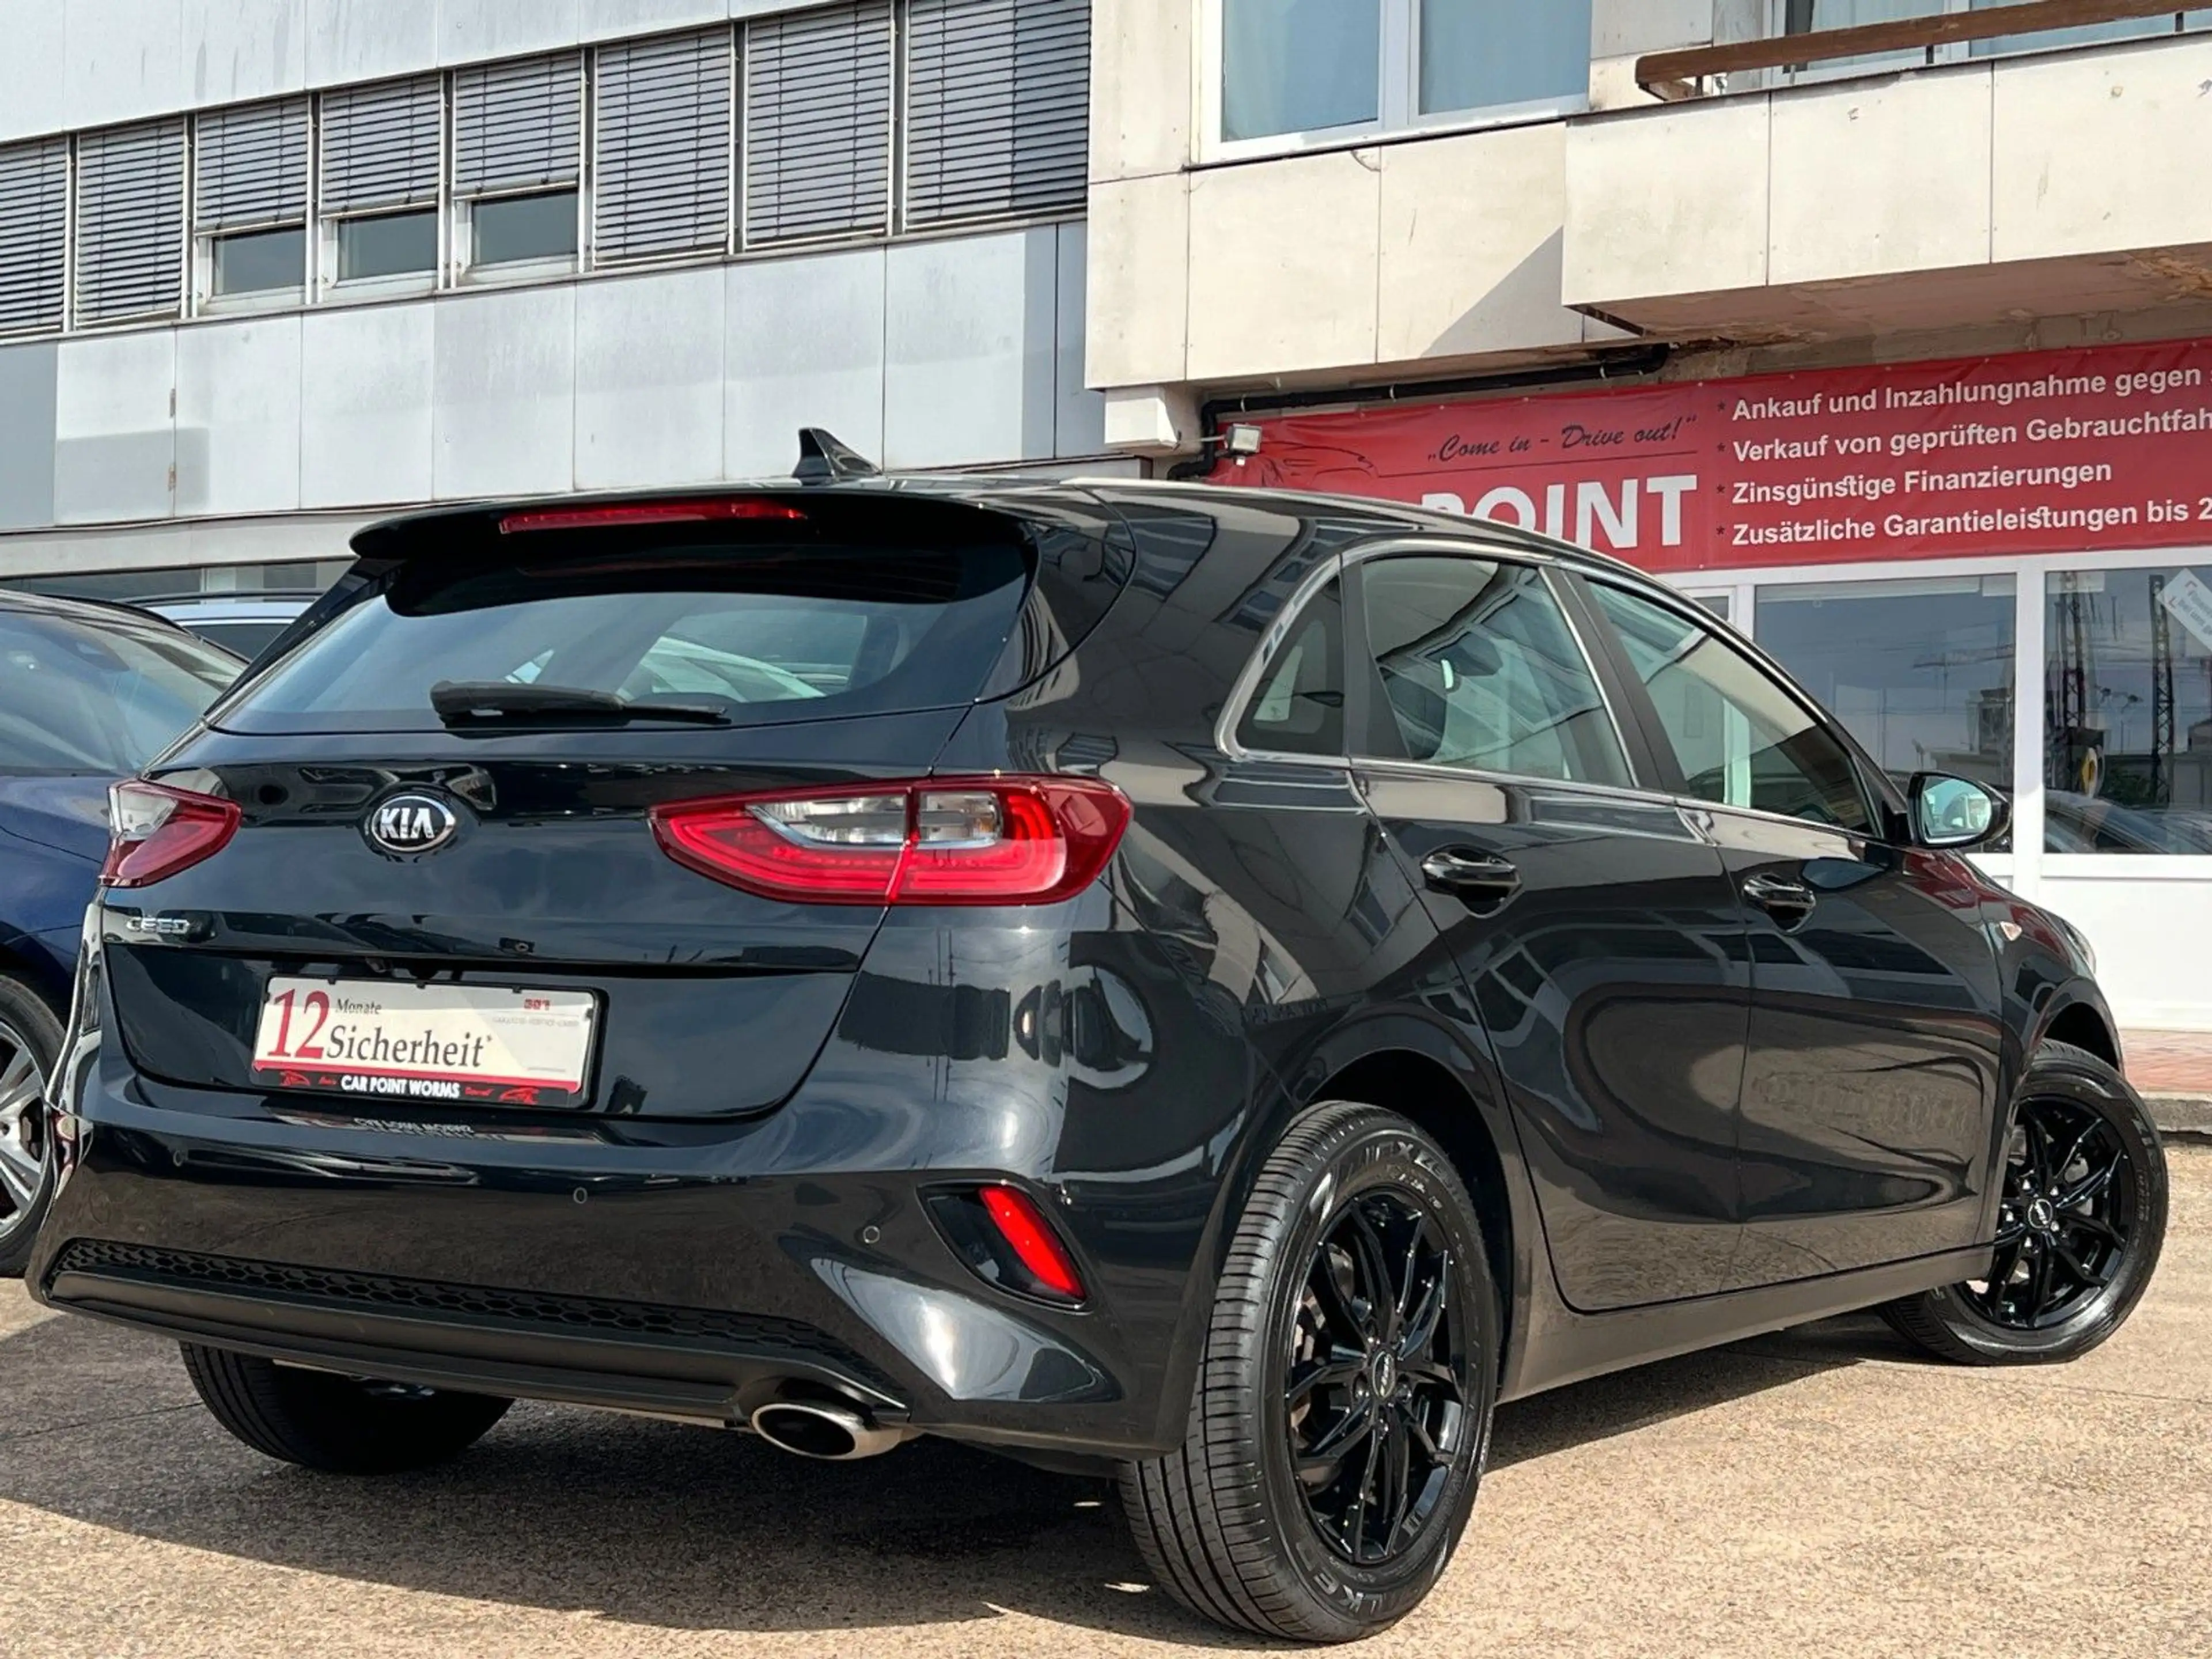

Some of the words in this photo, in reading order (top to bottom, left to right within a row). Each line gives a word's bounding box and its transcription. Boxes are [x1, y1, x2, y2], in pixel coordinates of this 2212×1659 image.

[1732, 393, 1823, 421] Ankauf
[1829, 389, 1877, 413] und
[1885, 374, 2106, 408] Inzahlungnahme
[2115, 368, 2201, 396] gegen
[1508, 435, 1532, 452] in
[1560, 424, 1624, 449] Drive
[1733, 435, 1829, 461] Verkauf
[1835, 435, 1881, 454] von
[1890, 423, 2016, 456] geprüften
[1732, 475, 1896, 505] Zinsgünstige
[1904, 463, 2112, 493] Finanzierungen
[1421, 475, 1698, 548] OINT
[1732, 518, 1876, 546] Zusätzliche
[1884, 506, 2137, 536] Garantieleistungen
[2146, 499, 2190, 522] bis
[380, 807, 435, 839] KIA
[267, 988, 330, 1059] 12
[335, 998, 382, 1014] Monate
[340, 1074, 368, 1092] CAR
[369, 1076, 407, 1094] POINT
[408, 1079, 461, 1099] WORMS
